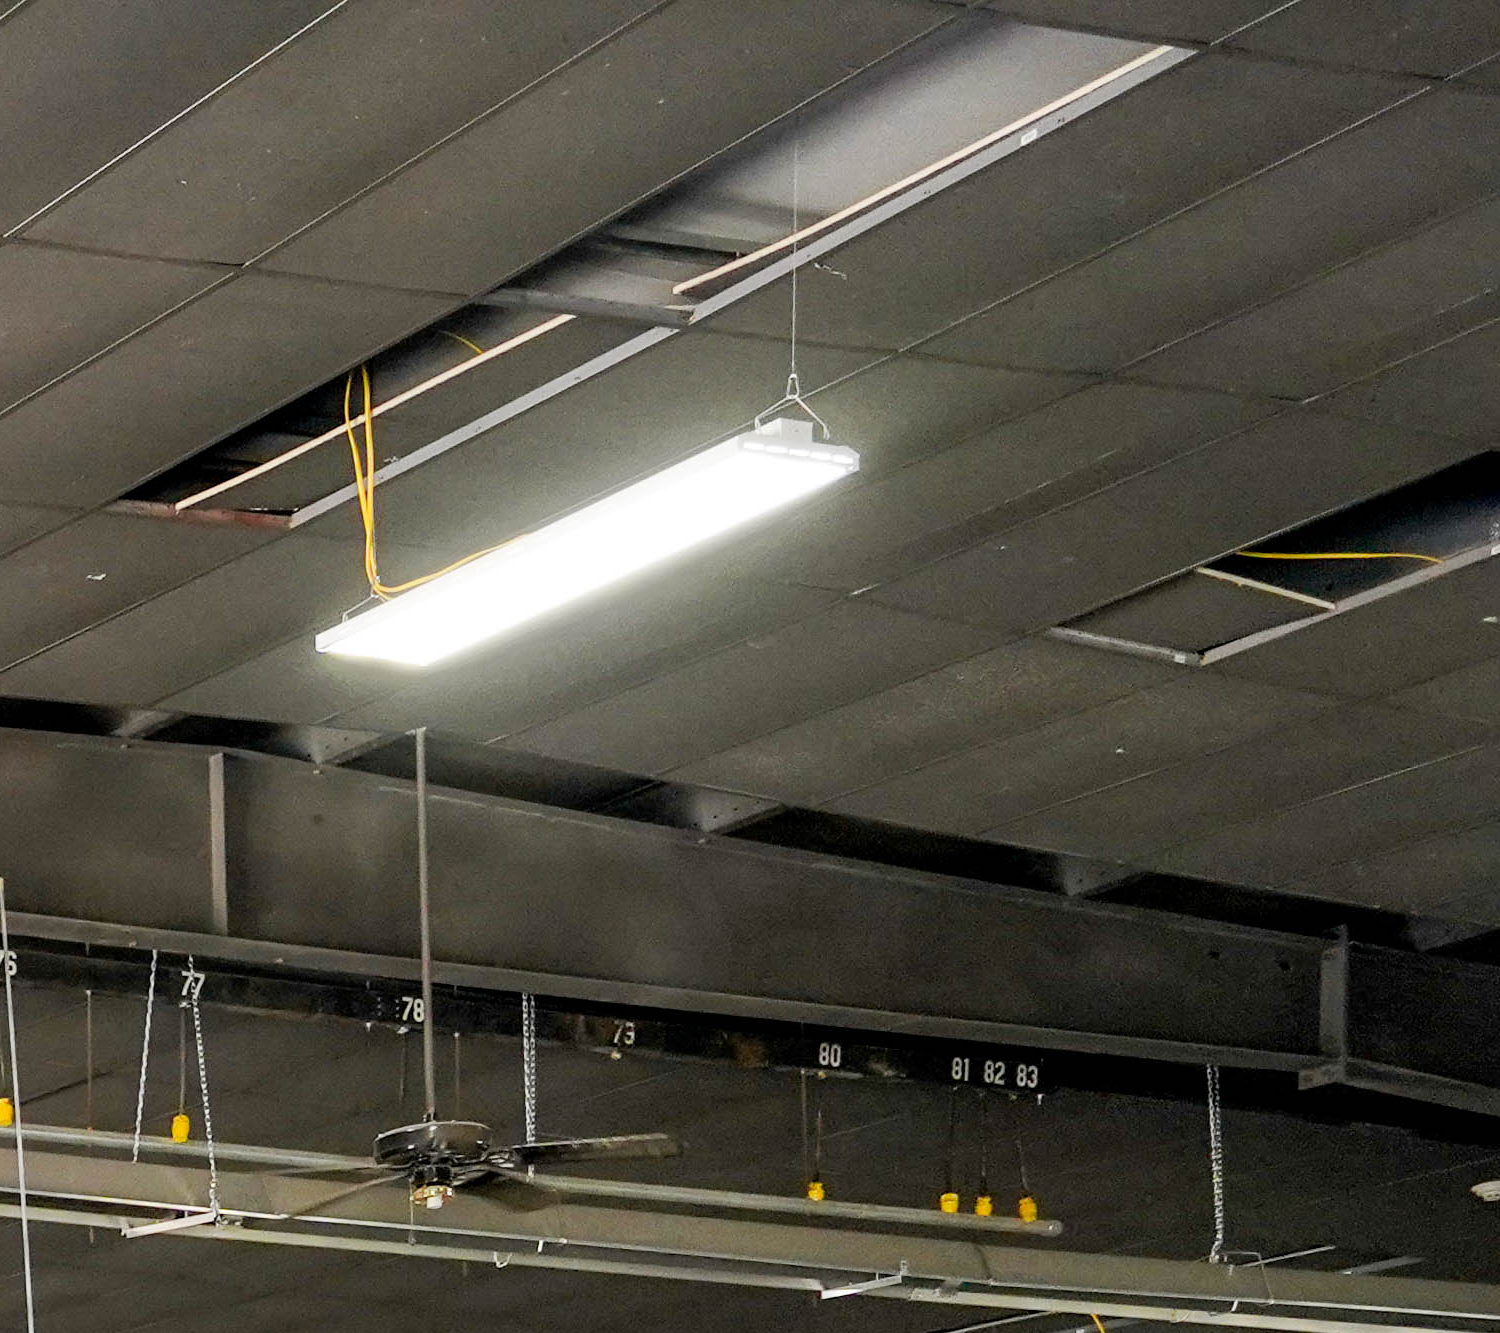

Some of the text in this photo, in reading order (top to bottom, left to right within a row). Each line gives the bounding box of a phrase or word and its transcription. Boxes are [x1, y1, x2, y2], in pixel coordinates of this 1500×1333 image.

[181, 970, 206, 999] 77
[401, 996, 425, 1023] 78
[819, 1043, 841, 1068] 80
[951, 1056, 1039, 1089] 81 82 83
